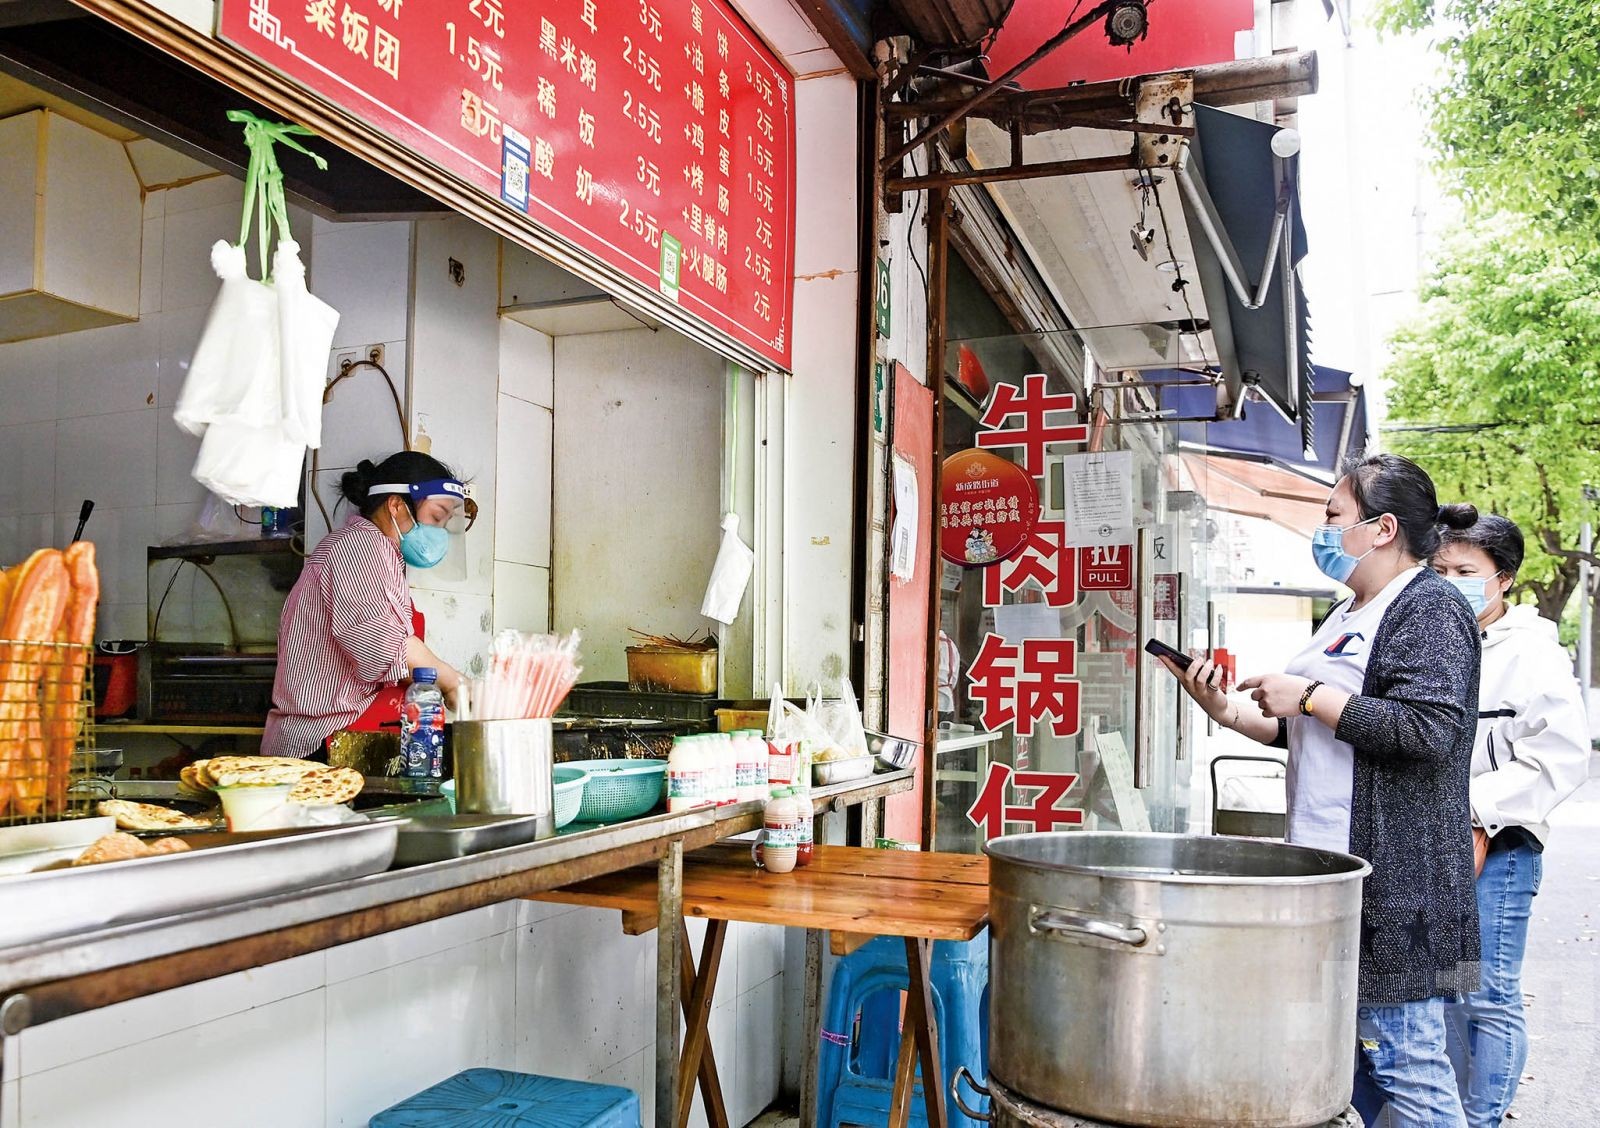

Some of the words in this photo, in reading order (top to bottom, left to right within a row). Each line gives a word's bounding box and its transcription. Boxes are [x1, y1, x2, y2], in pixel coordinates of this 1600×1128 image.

[639, 0, 663, 43] 3元
[446, 22, 504, 92] 1.5元
[623, 36, 662, 93] 2.5元
[539, 16, 598, 92] 黑米粥
[623, 90, 662, 145] 2.5元
[745, 61, 773, 107] 3.5元
[756, 107, 774, 142] 2元
[636, 155, 661, 197] 3元
[747, 135, 774, 177] 1.5元
[747, 172, 774, 213] 1.5元
[619, 198, 659, 250] 2.5元
[755, 216, 773, 250] 2元
[744, 246, 772, 286] 2.5元
[753, 290, 771, 322] 2元
[1088, 573, 1121, 584] PULL
